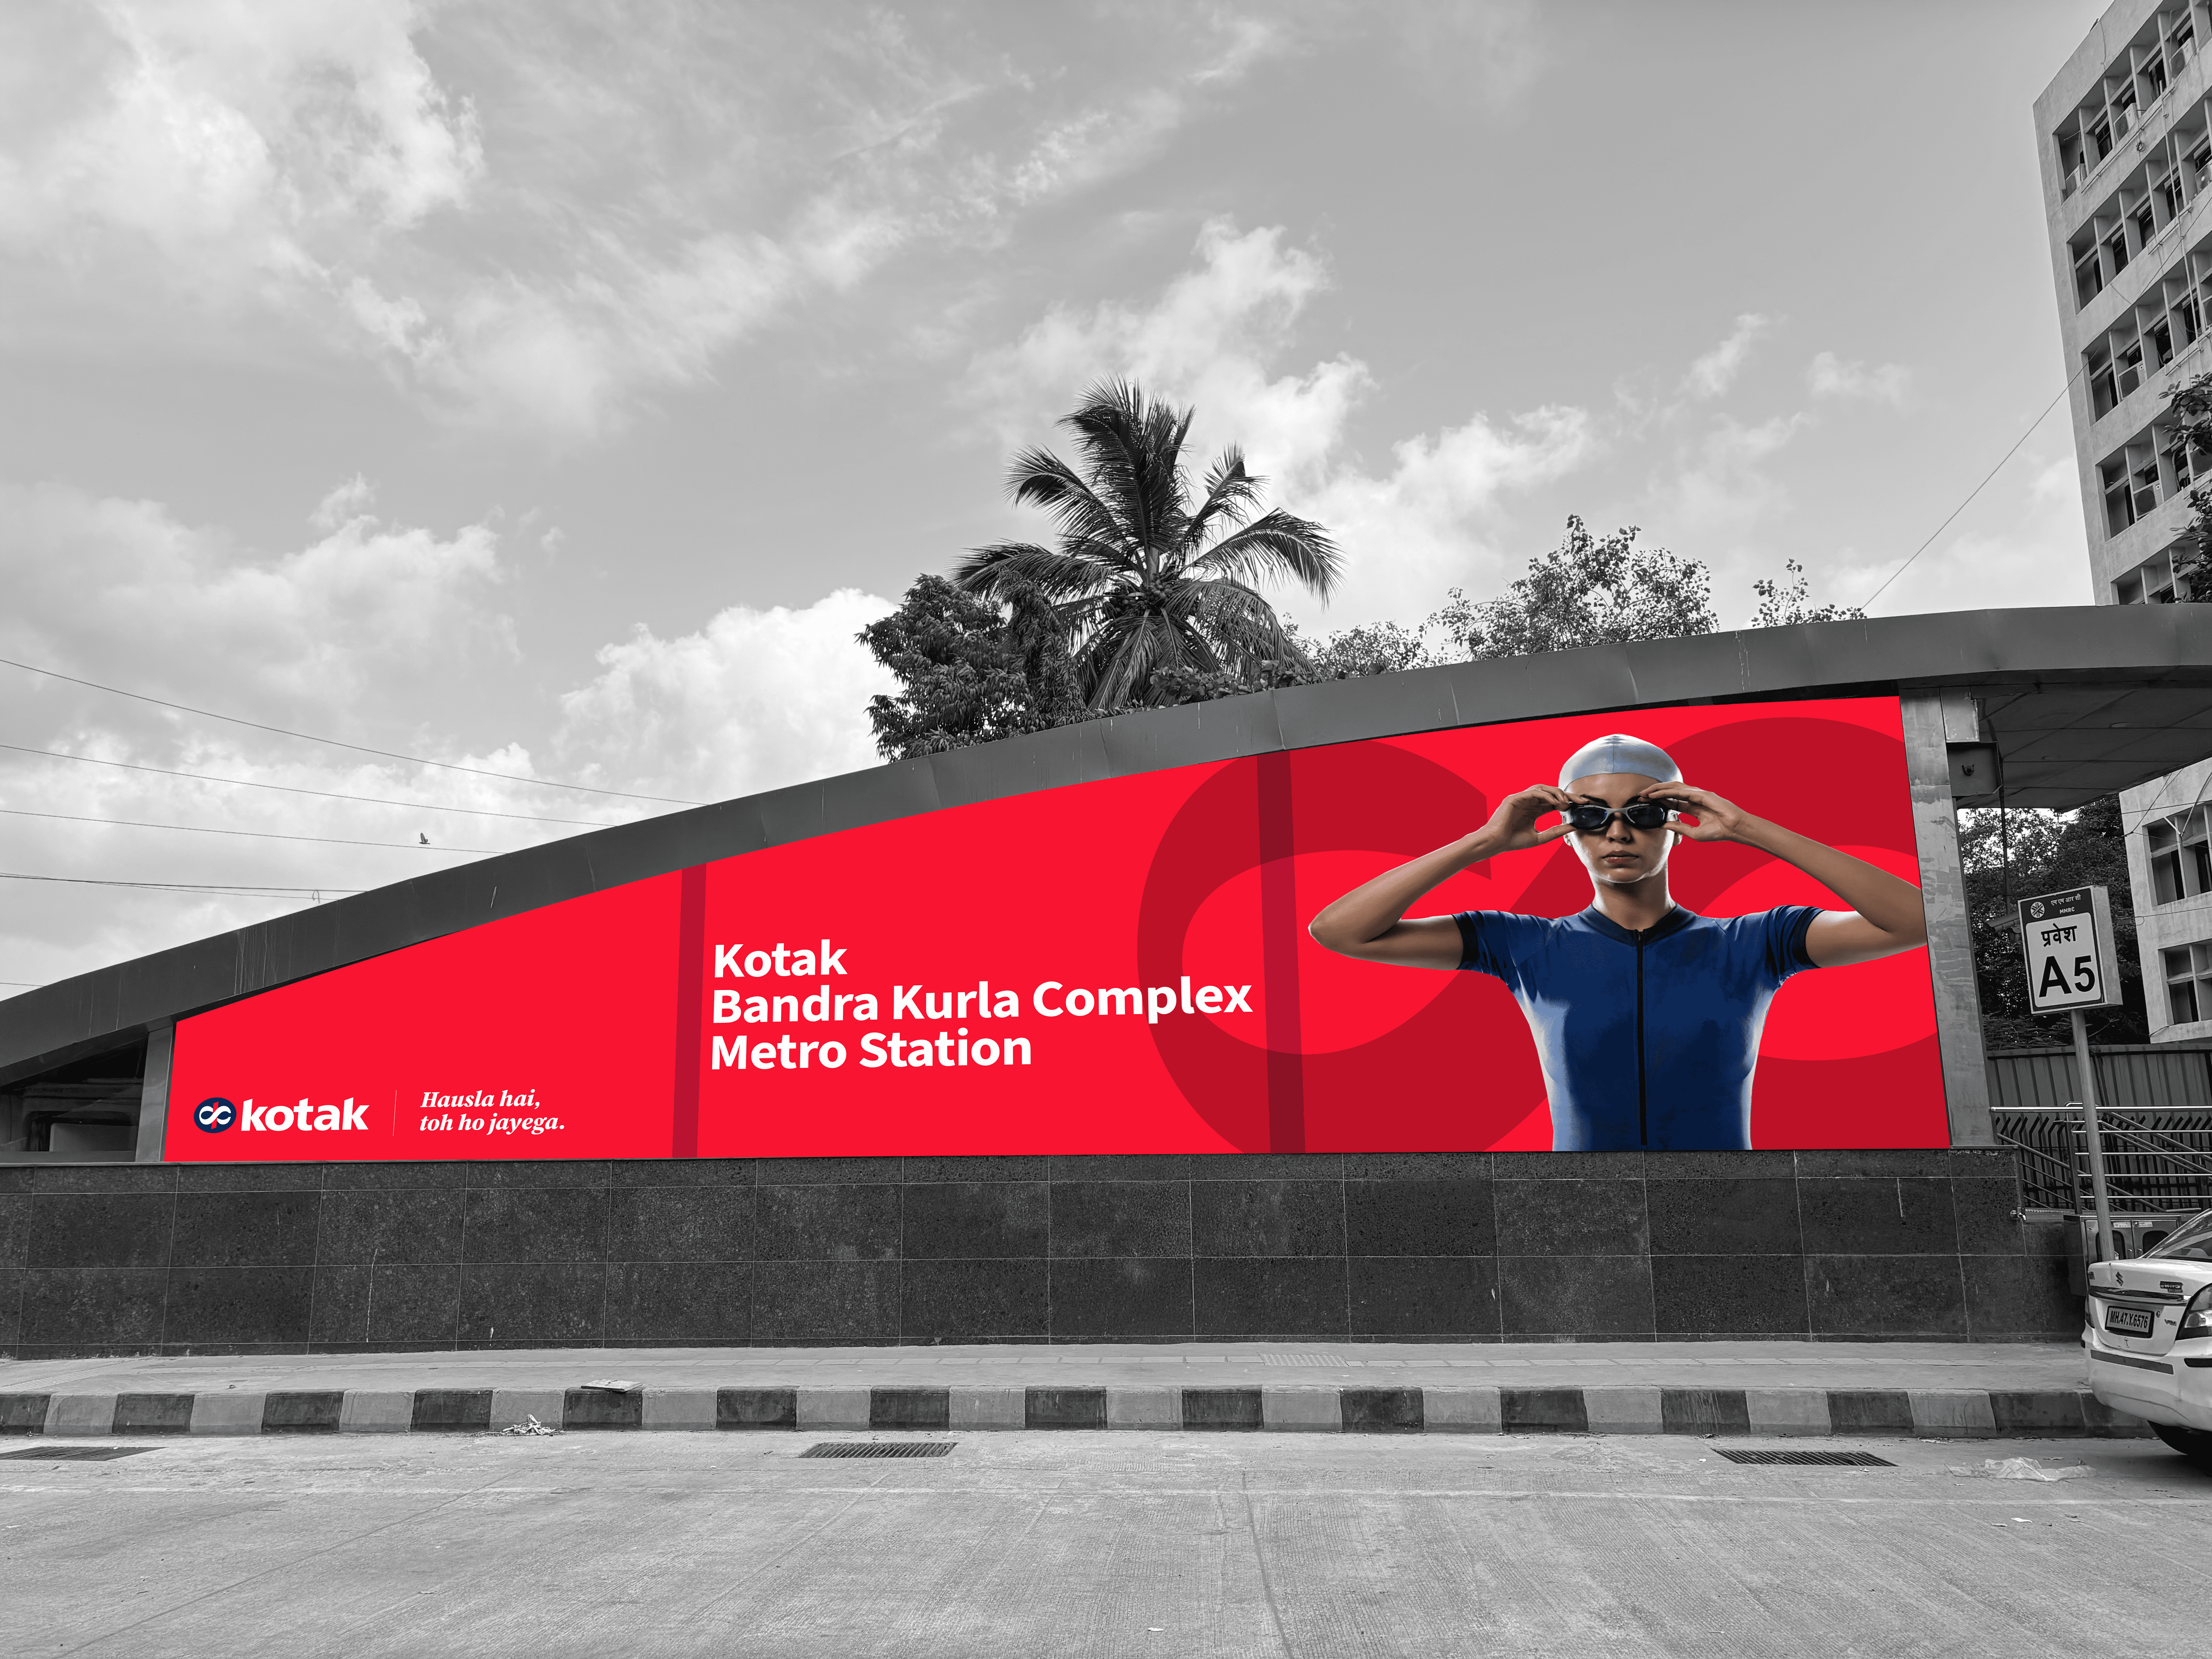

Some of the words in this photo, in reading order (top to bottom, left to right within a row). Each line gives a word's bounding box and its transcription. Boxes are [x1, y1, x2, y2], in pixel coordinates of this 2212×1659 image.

[2040, 922, 2077, 947] प्रवेश
[714, 939, 848, 978] Kotak
[2039, 955, 2095, 998] A5
[713, 985, 878, 1024] Bandra
[893, 981, 1019, 1020] Kurla
[1033, 976, 1254, 1024] Complex
[712, 1032, 847, 1070] Metro
[859, 1027, 1031, 1068] Station
[241, 1097, 370, 1131] kotak
[420, 1090, 495, 1108] Hausla
[499, 1089, 540, 1109] hai,
[419, 1113, 453, 1131] toh
[458, 1113, 484, 1130] ho
[486, 1113, 565, 1135] jayega.
